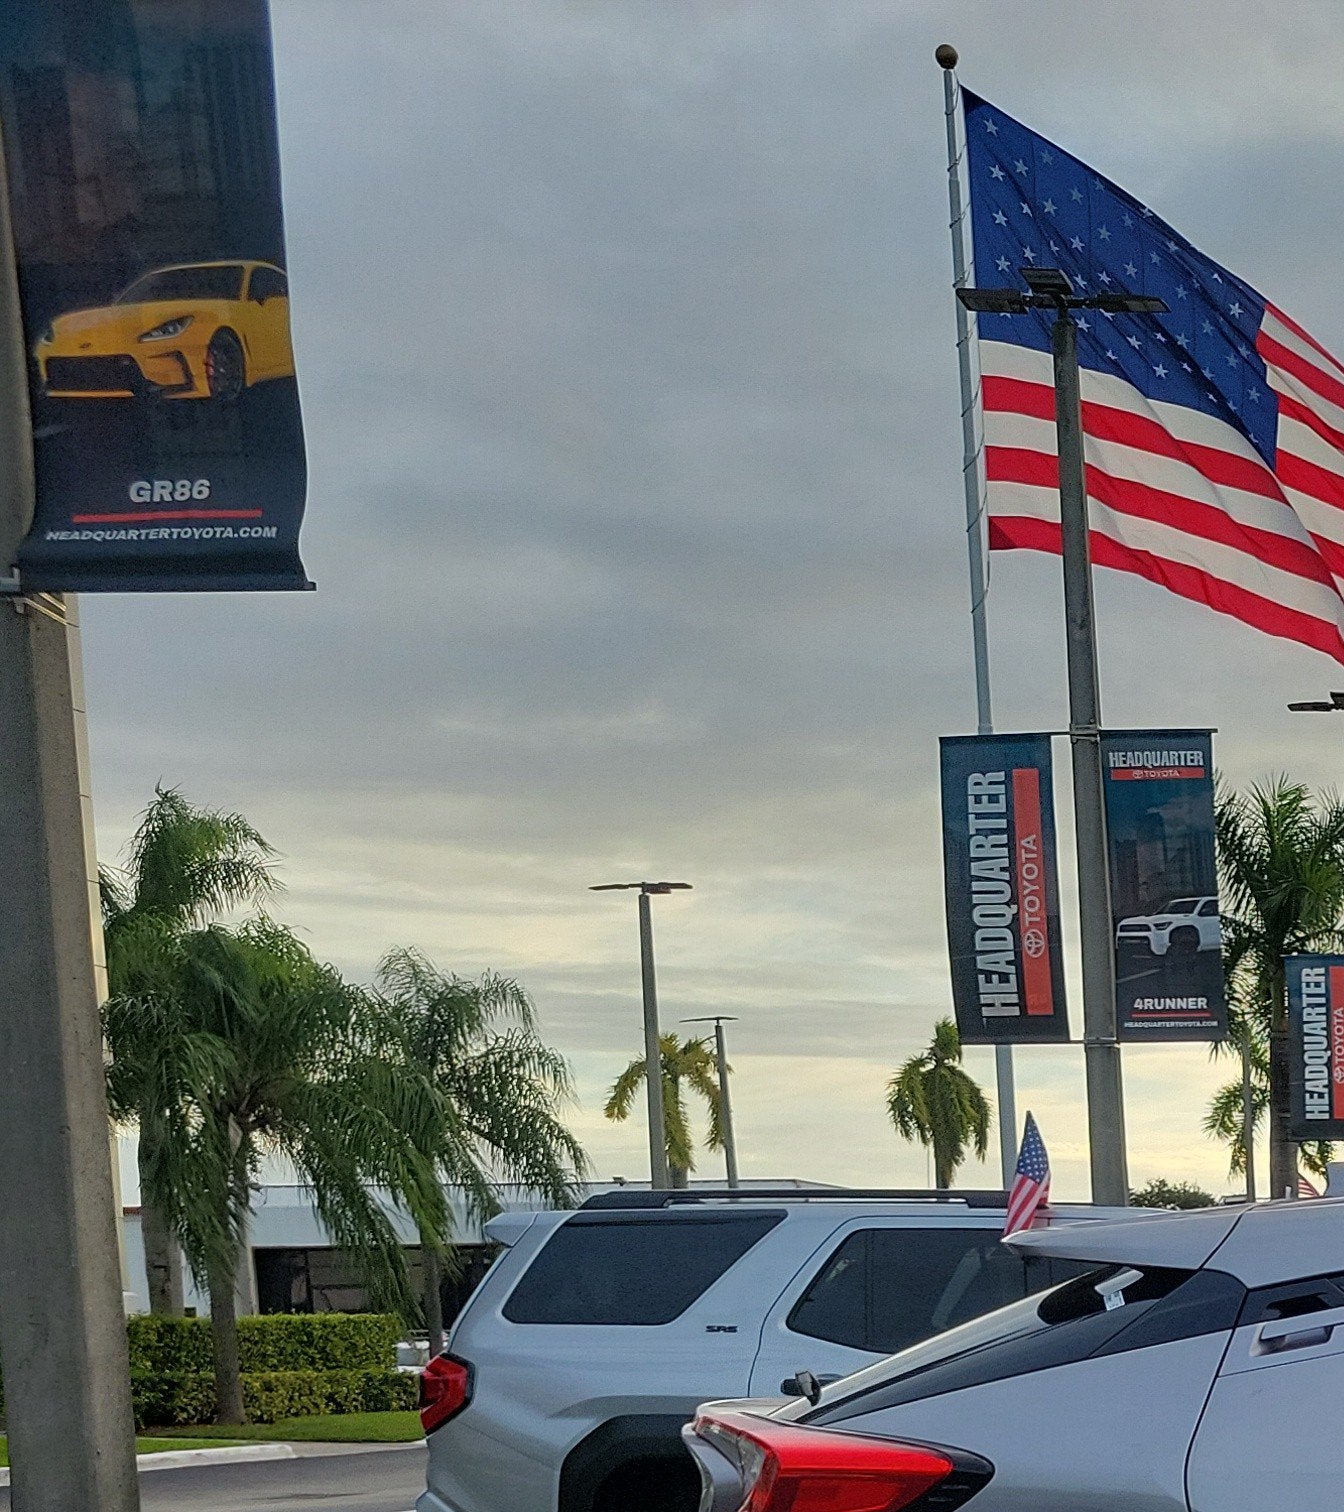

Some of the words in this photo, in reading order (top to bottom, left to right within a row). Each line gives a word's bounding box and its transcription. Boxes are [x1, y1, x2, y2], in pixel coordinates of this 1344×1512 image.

[128, 479, 211, 503] GR86
[46, 526, 277, 542] HEADQUARTERTOYOTA.COM
[1108, 751, 1204, 768] HEADQUARTER
[1021, 834, 1042, 926] TOYOTA
[967, 771, 1021, 1017] HEADQUARTER
[1133, 997, 1208, 1010] 4RUNNER
[1301, 967, 1332, 1120] HEADQUARTER
